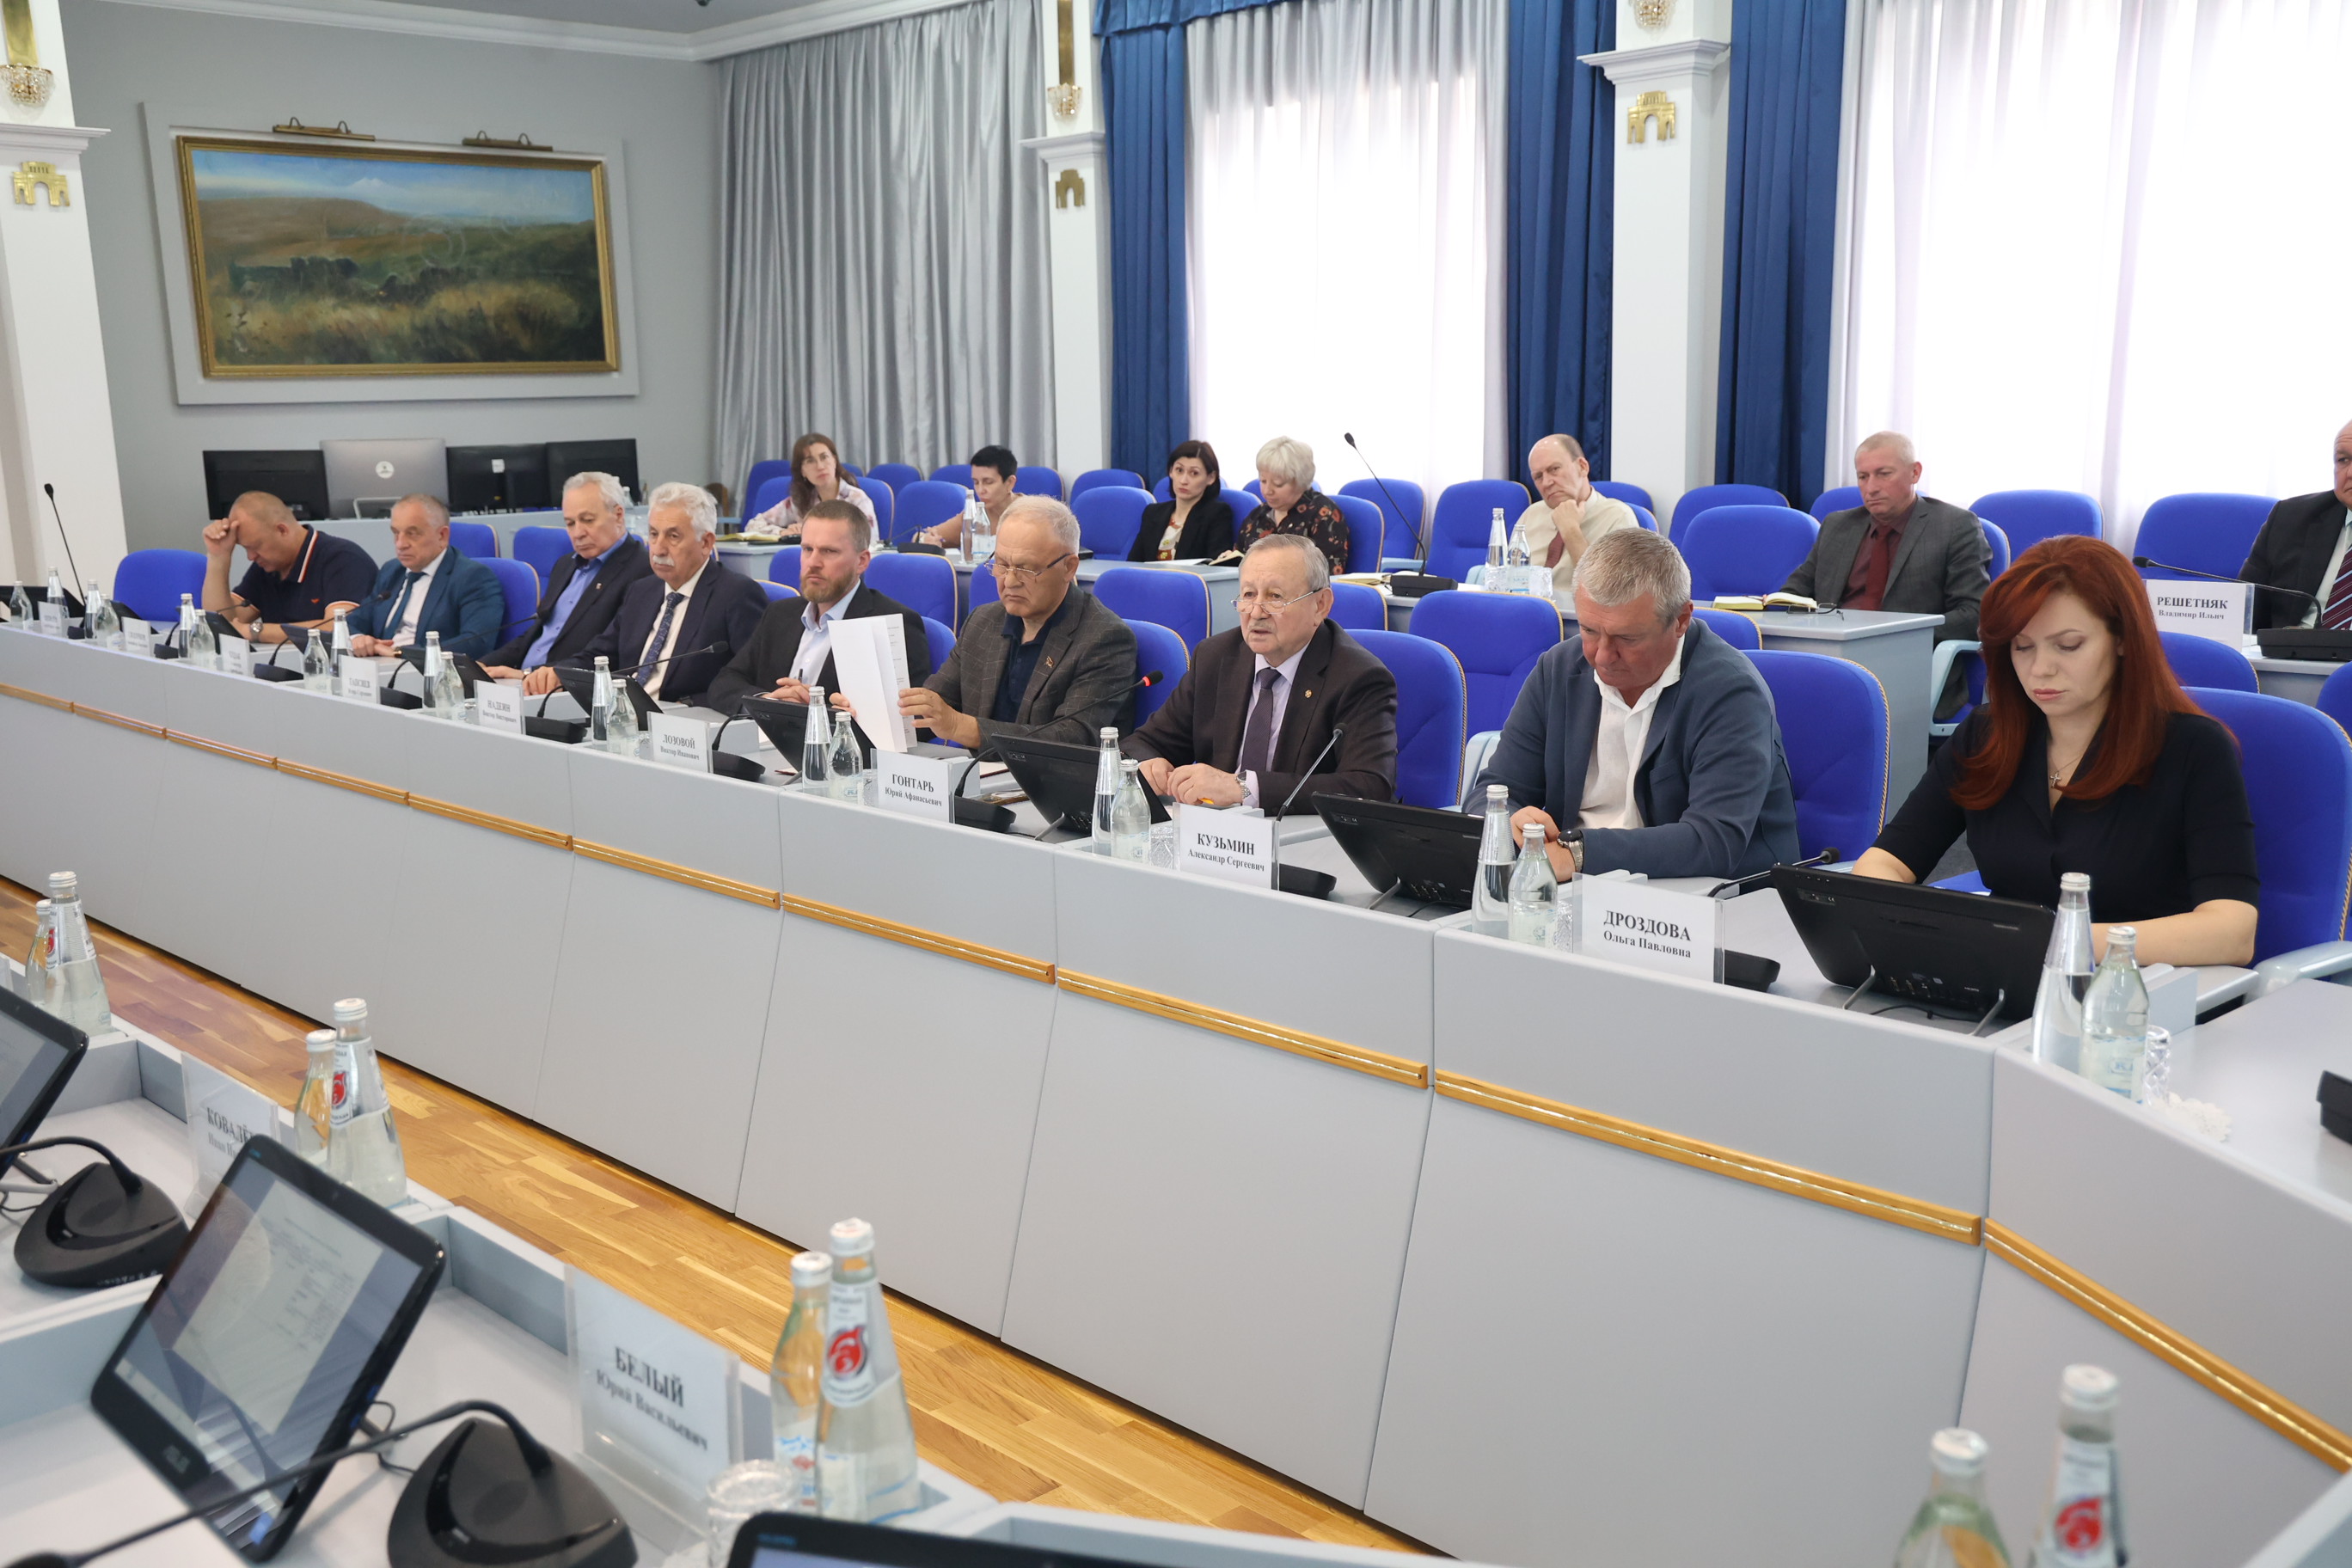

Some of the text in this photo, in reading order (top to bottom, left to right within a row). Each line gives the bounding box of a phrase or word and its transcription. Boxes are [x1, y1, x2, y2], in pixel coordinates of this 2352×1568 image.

[2157, 597, 2228, 609] РЕШЕТНЯК
[2159, 609, 2224, 620] Владимир Ильич
[663, 733, 695, 749] ЛОЗОВОЙ
[891, 774, 934, 793] ГОНТАРЬ
[885, 787, 942, 806] Юрий Афанасьевич
[1197, 832, 1255, 855] КУЗЬМИН
[1187, 848, 1265, 872] Александр Сергеевич
[1603, 910, 1692, 941] ДРОЗДОВА
[1603, 930, 1692, 958] Ольга Павловна
[206, 1106, 255, 1144] КОВАЛЁ
[615, 1345, 684, 1409] БЕЛЫЙ
